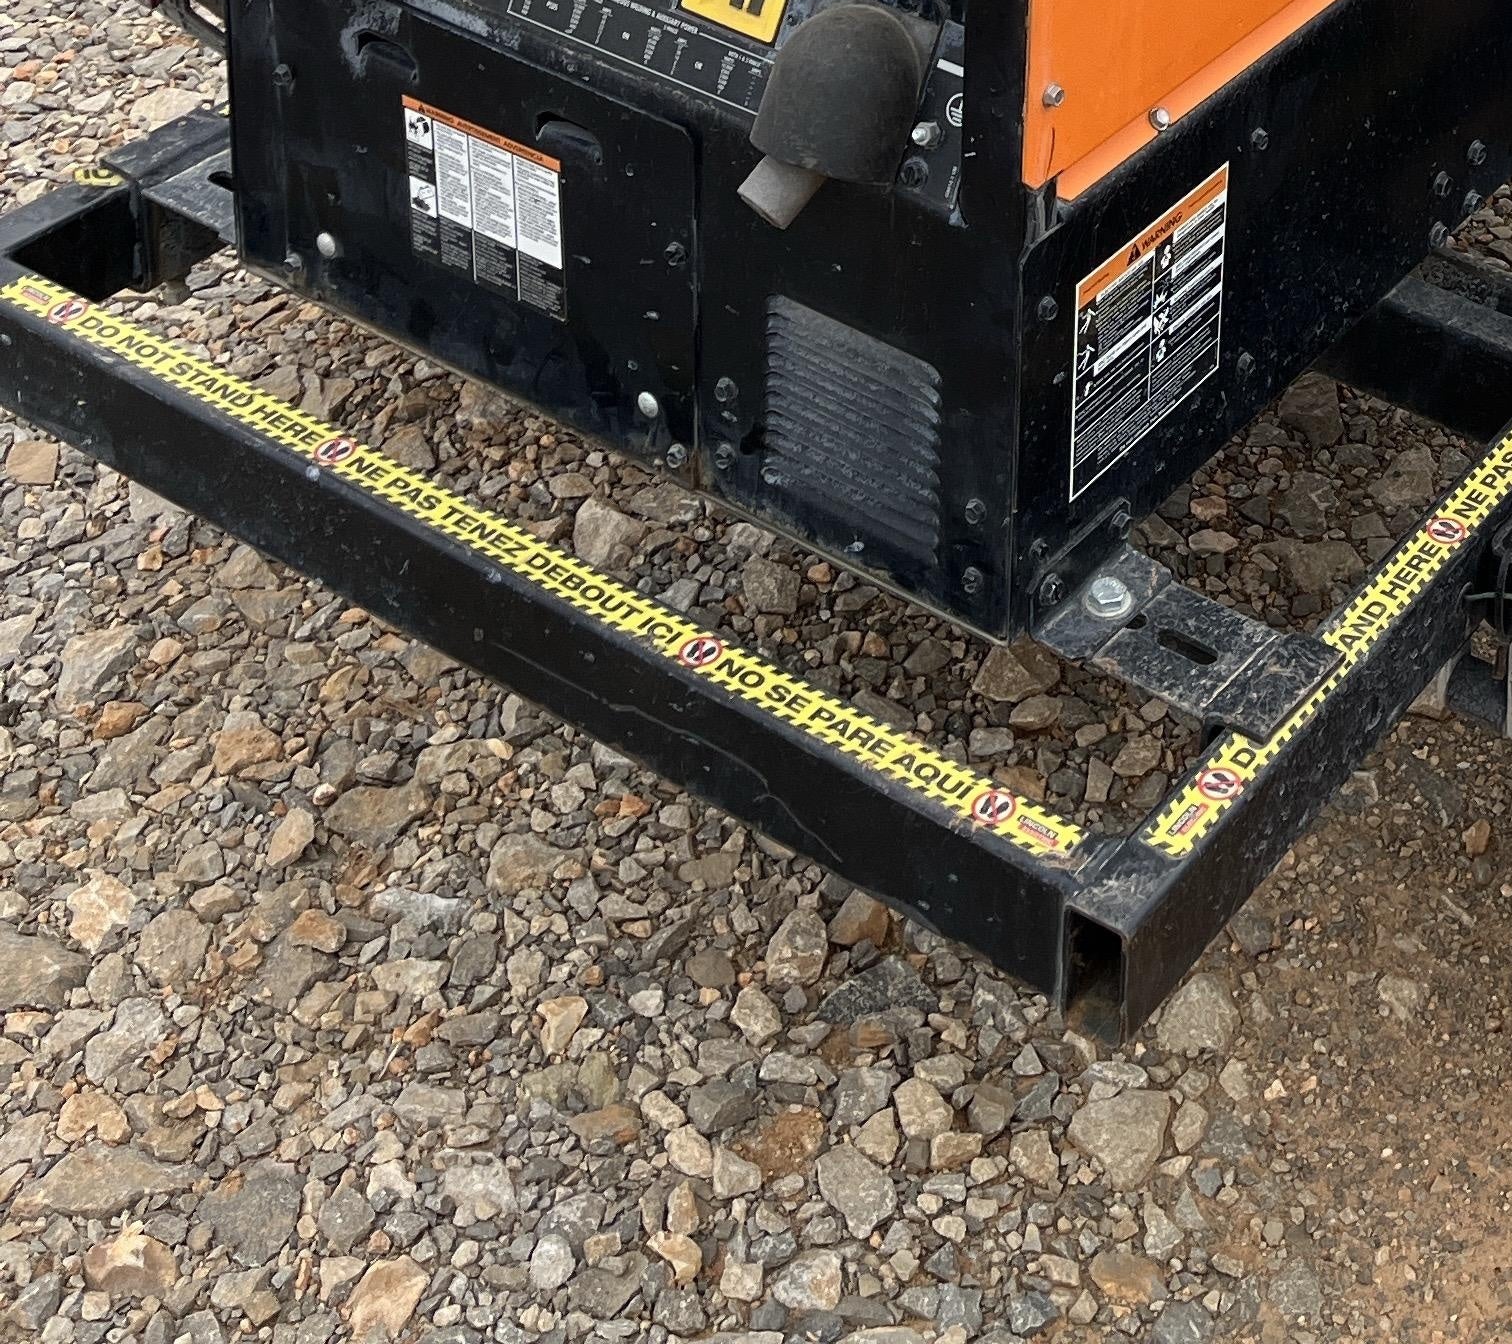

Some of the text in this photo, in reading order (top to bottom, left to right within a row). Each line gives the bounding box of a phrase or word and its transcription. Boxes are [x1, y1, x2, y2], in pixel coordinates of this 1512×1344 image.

[1141, 211, 1183, 251] WARNING
[78, 316, 120, 340] DO
[117, 334, 174, 366] NOT
[168, 361, 255, 410] STAND
[251, 405, 326, 448] HERE
[345, 456, 384, 483] NE
[383, 476, 442, 512] PAS
[446, 504, 531, 560] TENEZ
[526, 551, 646, 622] DEBOUT
[637, 616, 684, 646] ICI
[714, 657, 766, 689] NO
[763, 683, 813, 714] SE
[808, 705, 895, 759] PARE
[1340, 598, 1385, 651] AND
[1384, 539, 1443, 599] HERE
[1454, 483, 1489, 521] NE
[1019, 815, 1058, 840] LINCOLN
